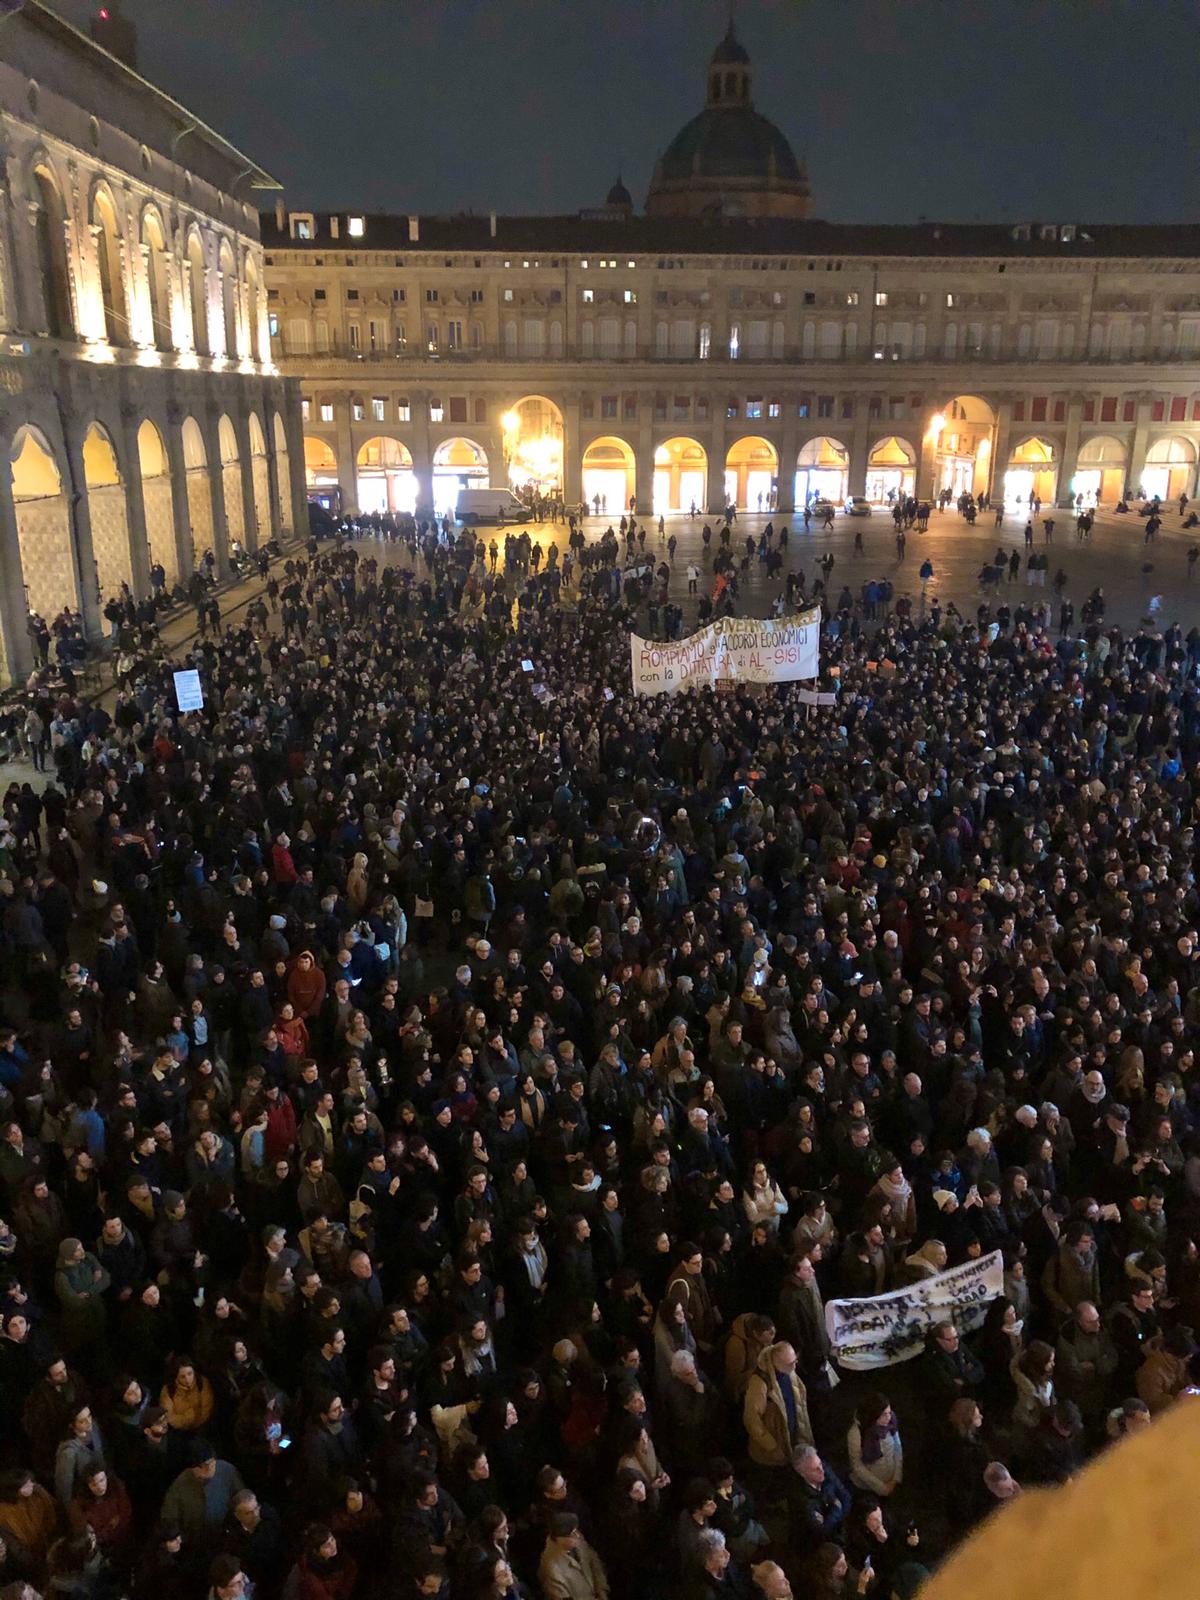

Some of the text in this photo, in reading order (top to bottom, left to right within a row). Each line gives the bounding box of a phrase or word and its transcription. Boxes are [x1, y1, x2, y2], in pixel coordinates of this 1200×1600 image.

[640, 641, 705, 668] ROMPIAMO
[720, 633, 758, 652] ACCORDI
[761, 627, 808, 648] ECONOMICI
[640, 672, 660, 682] con
[664, 667, 674, 680] la
[680, 653, 733, 680] DITTATURA
[738, 654, 746, 667] di
